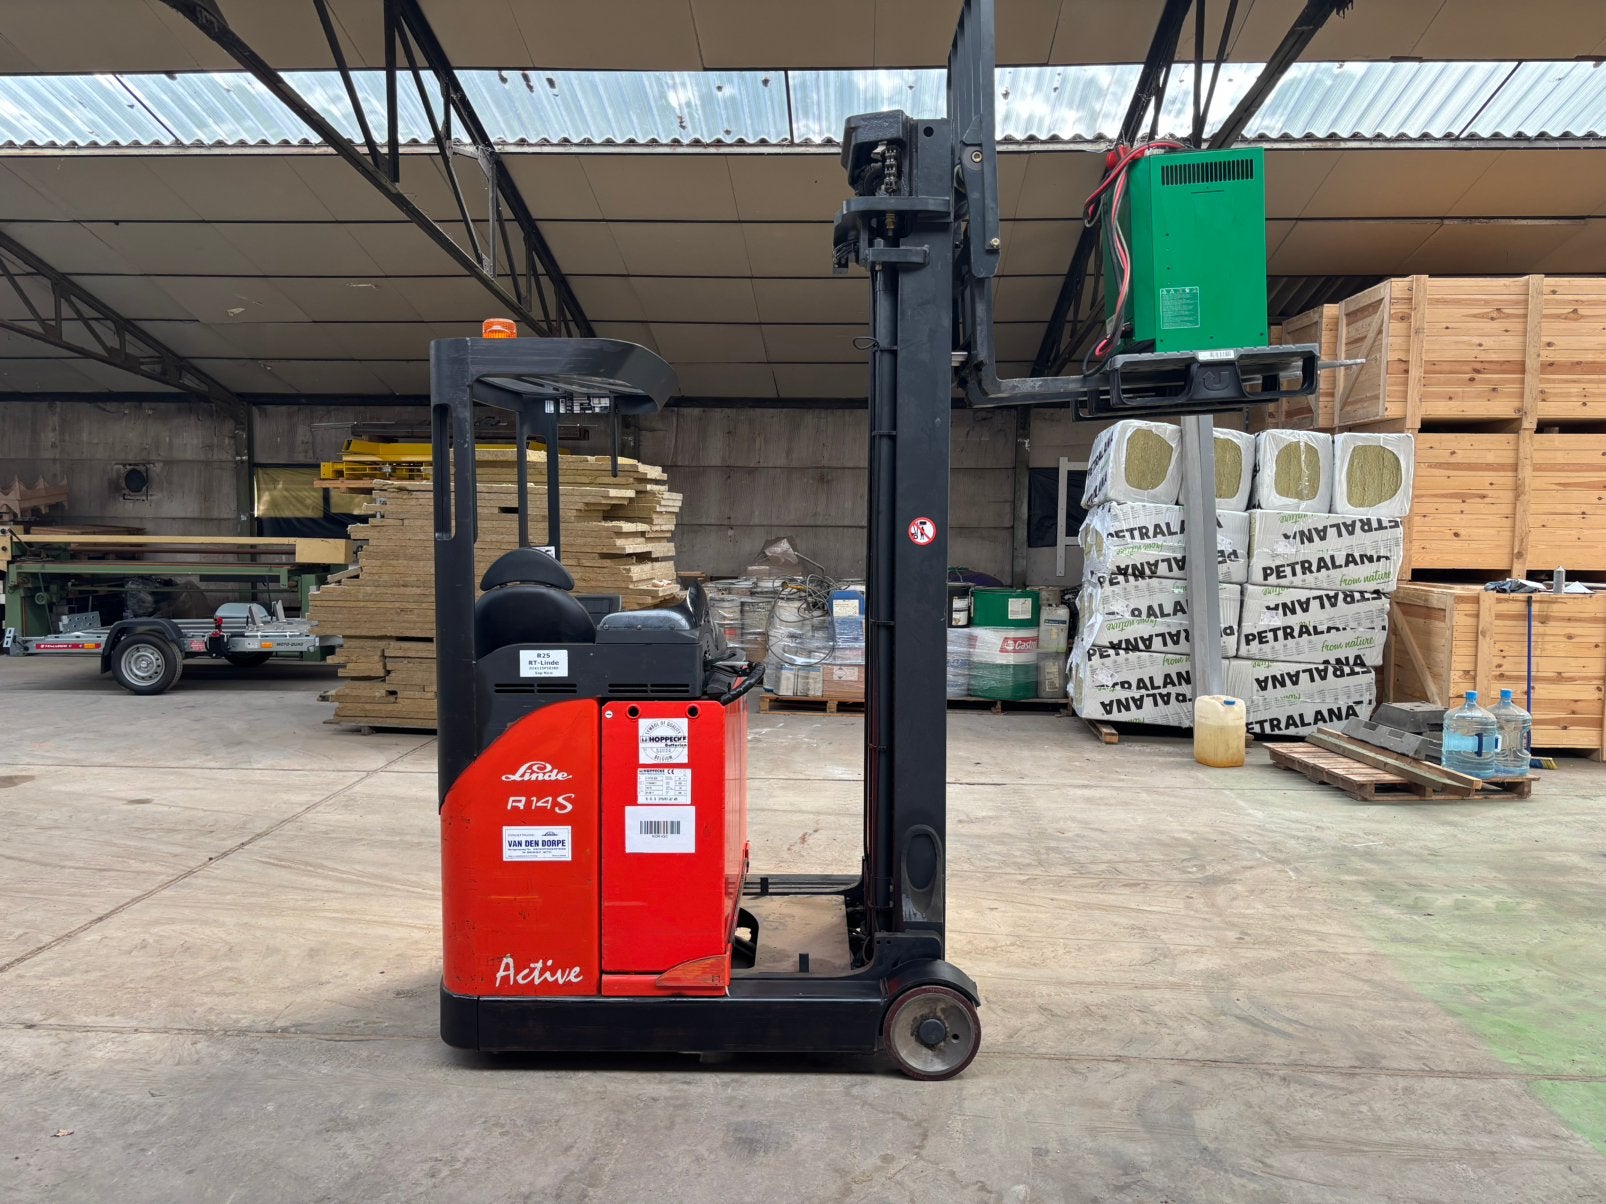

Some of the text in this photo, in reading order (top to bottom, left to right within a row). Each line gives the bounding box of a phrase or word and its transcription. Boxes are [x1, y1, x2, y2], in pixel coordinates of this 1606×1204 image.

[1282, 517, 1402, 546] ETRALAN
[1339, 570, 1393, 588] from nature
[1106, 619, 1136, 632] nature
[1321, 635, 1375, 652] from nature
[501, 761, 573, 781] Linde
[507, 839, 567, 848] VAN DEN DORPE
[495, 953, 584, 987] Active
